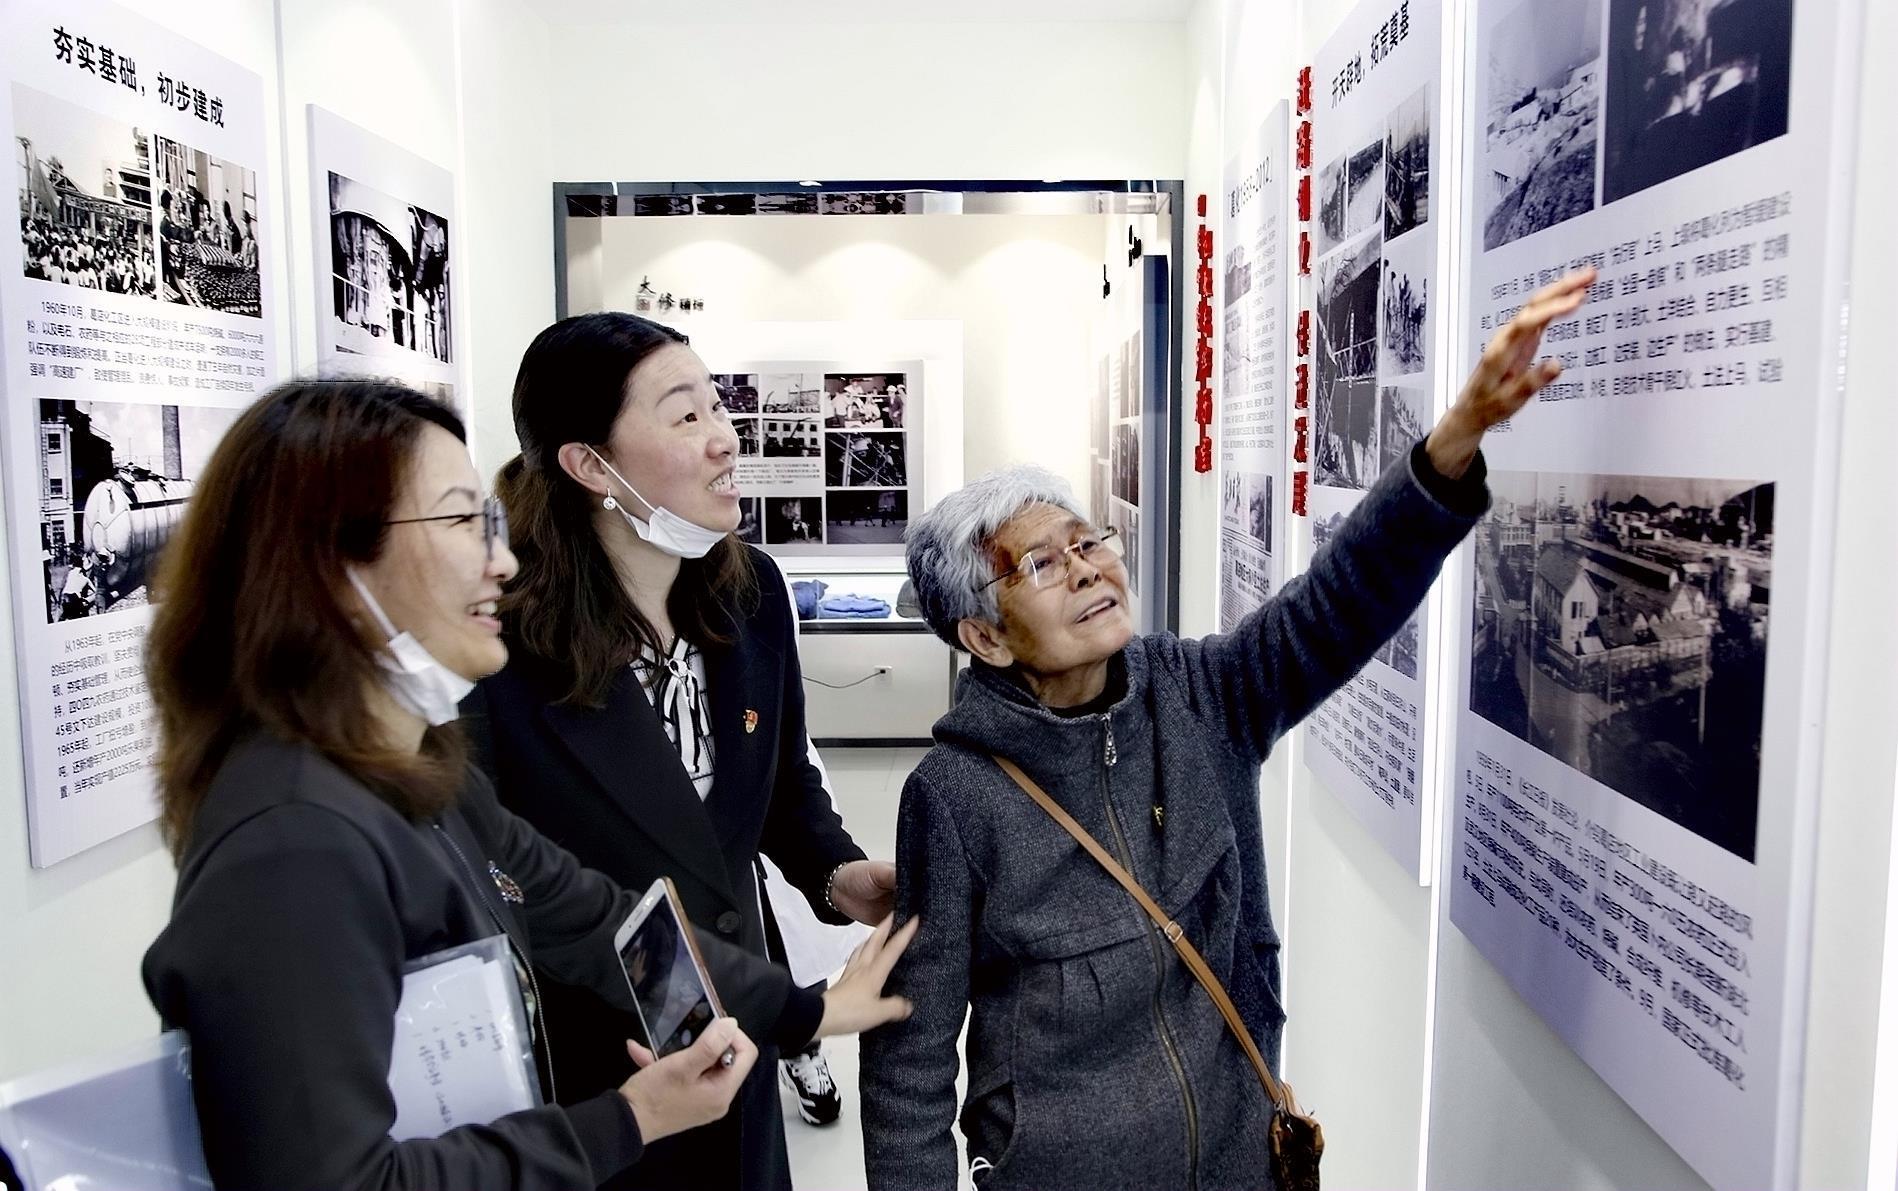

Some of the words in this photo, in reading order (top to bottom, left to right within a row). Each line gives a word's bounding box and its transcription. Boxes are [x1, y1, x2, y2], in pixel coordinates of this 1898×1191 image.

[53, 26, 225, 129] 夯实基础，初步建成
